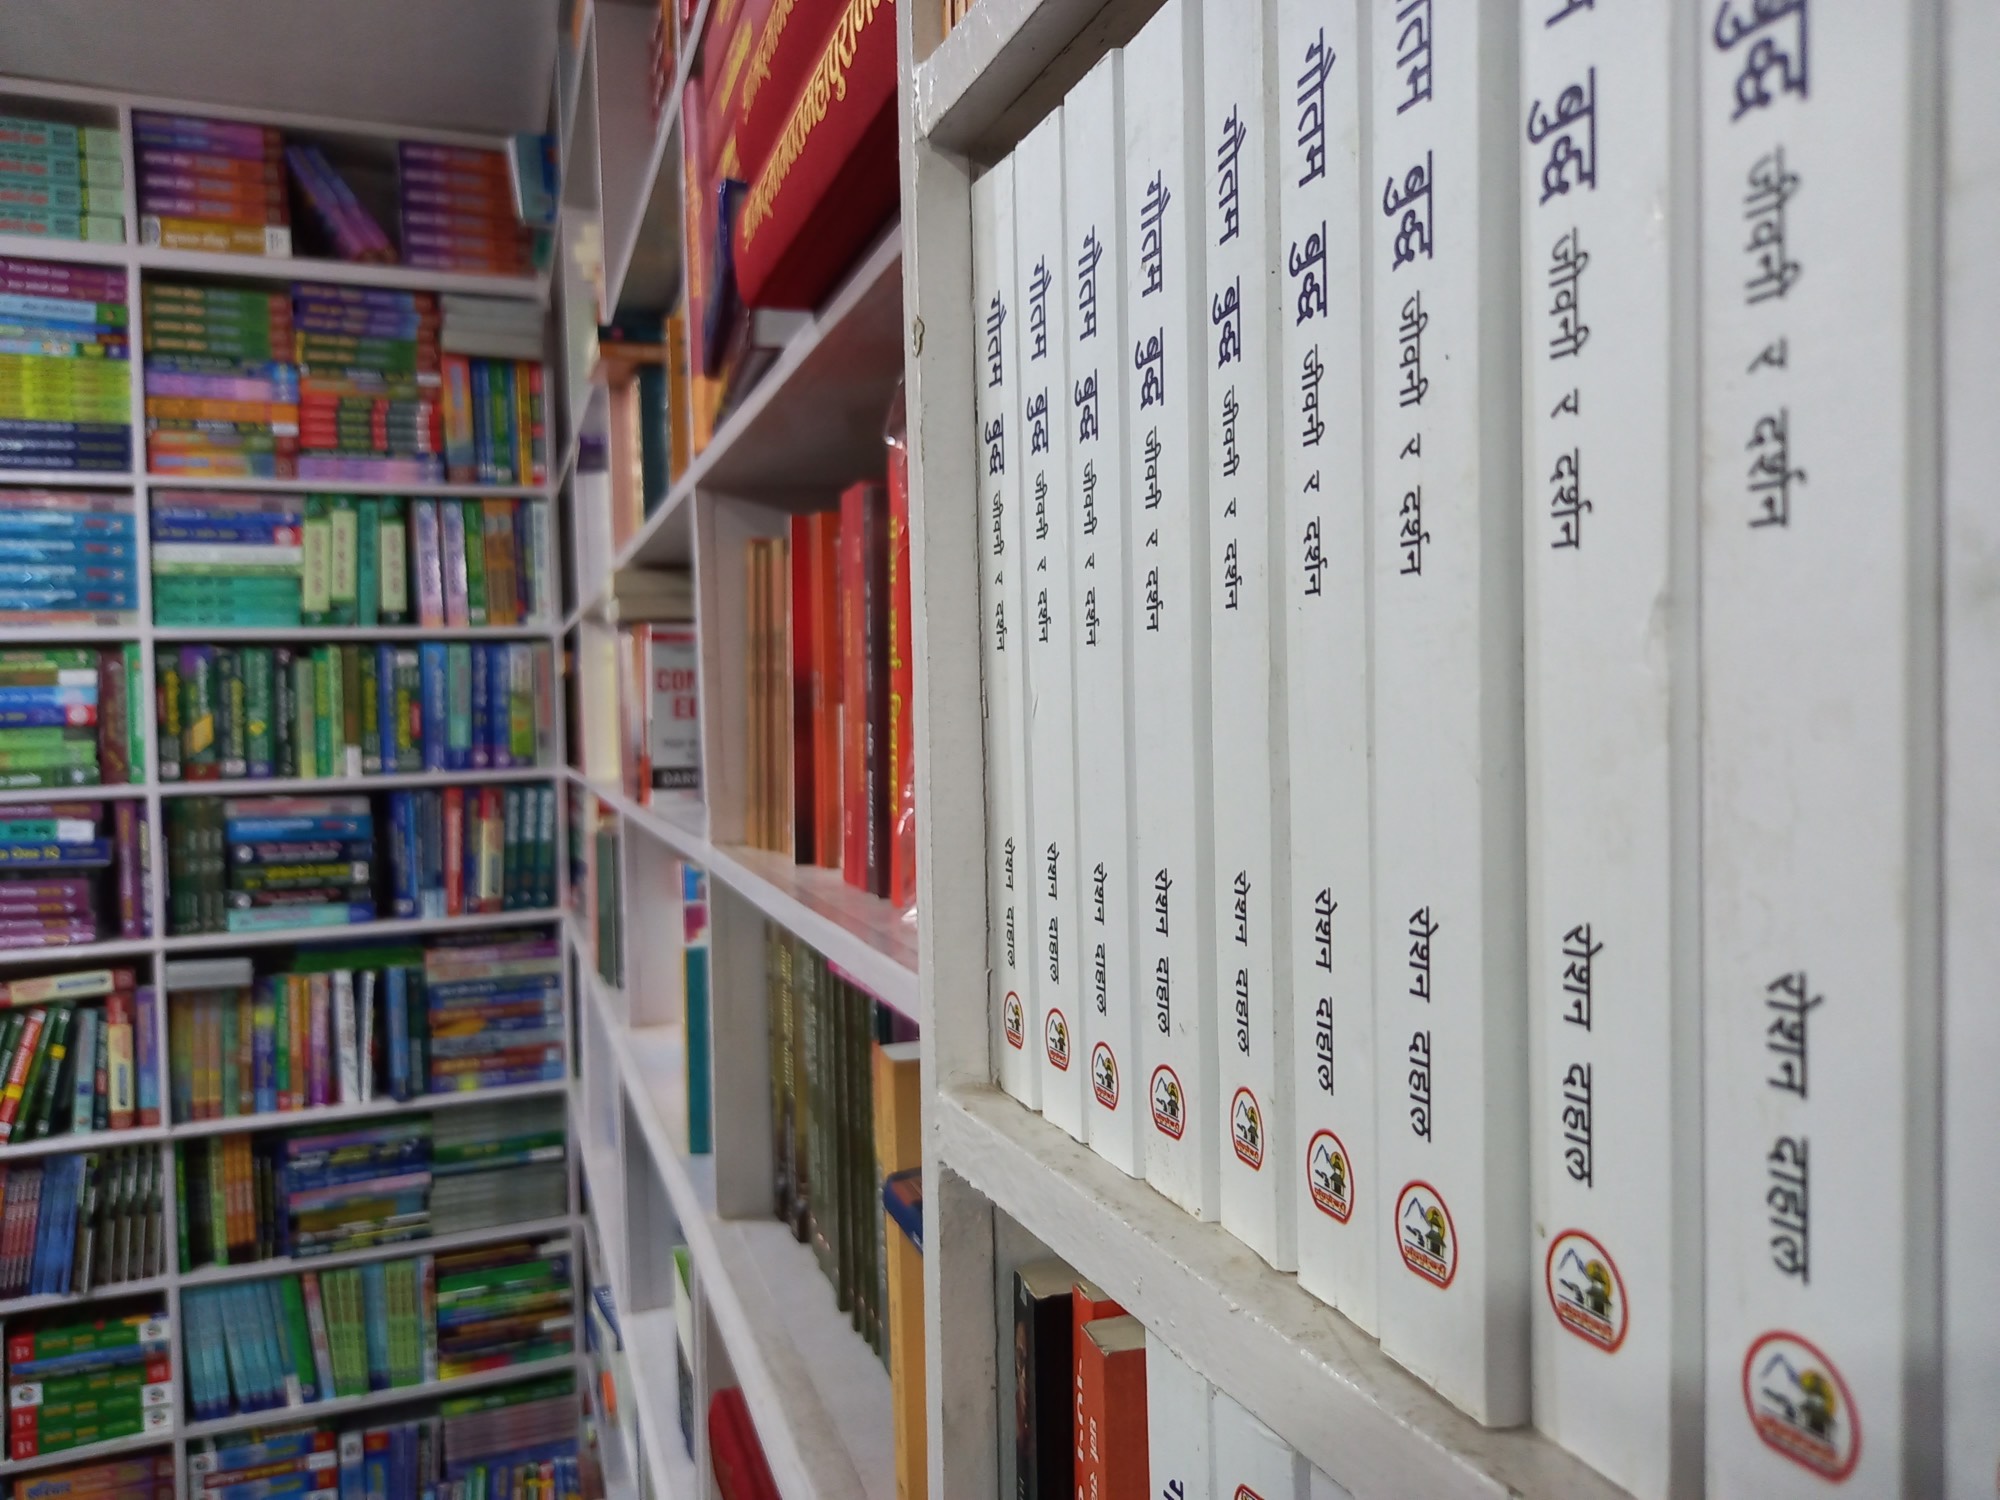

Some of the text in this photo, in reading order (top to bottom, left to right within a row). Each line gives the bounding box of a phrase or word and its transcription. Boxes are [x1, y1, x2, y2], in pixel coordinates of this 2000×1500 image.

[1528, 66, 1597, 204] बुद्ध
[1382, 149, 1434, 272] बुद्ध
[1746, 149, 1801, 305] जीवनी
[986, 290, 1007, 388] गौतम
[1029, 254, 1052, 362] गौतम
[1211, 103, 1247, 611] गौतम बुद्ध जीवनी र दर्शन
[1289, 26, 1337, 597] गौतम बुद्ध जीवनी र दर्शन
[1398, 289, 1429, 408] जीवनी
[1549, 226, 1591, 360] जीवनी
[1748, 339, 1787, 372] र
[985, 413, 1005, 477] बुद्ध
[1026, 386, 1050, 456] बुद्ध
[1074, 224, 1103, 647] गौतम बुद्ध जीवनी र दर्शन
[1134, 169, 1171, 633] गौतम बुद्ध जीवनी र दर्शन
[1399, 432, 1421, 460] र
[1550, 387, 1579, 419] र
[1399, 484, 1431, 577] दर्शन
[1549, 447, 1593, 550] दर्शन
[1747, 409, 1807, 529] दर्शन
[994, 570, 1003, 585] र
[995, 600, 1008, 652] दर्शन
[1036, 555, 1047, 572] र
[1037, 587, 1052, 643] दर्शन
[1004, 836, 1016, 970] रोशन दाहाल
[1046, 841, 1060, 985] रोशन दाहाल
[1093, 861, 1108, 1017] रोशन दाहाल
[1154, 867, 1173, 1038] रोशन दाहाल
[1233, 869, 1252, 1058] रोशन दाहाल
[1314, 886, 1339, 1097] रोशन दाहाल
[1408, 905, 1440, 1144] रोशन दाहाल
[1562, 922, 1604, 1189] रोशन दाहाल
[1766, 972, 1824, 1285] रोशन दाहाल
